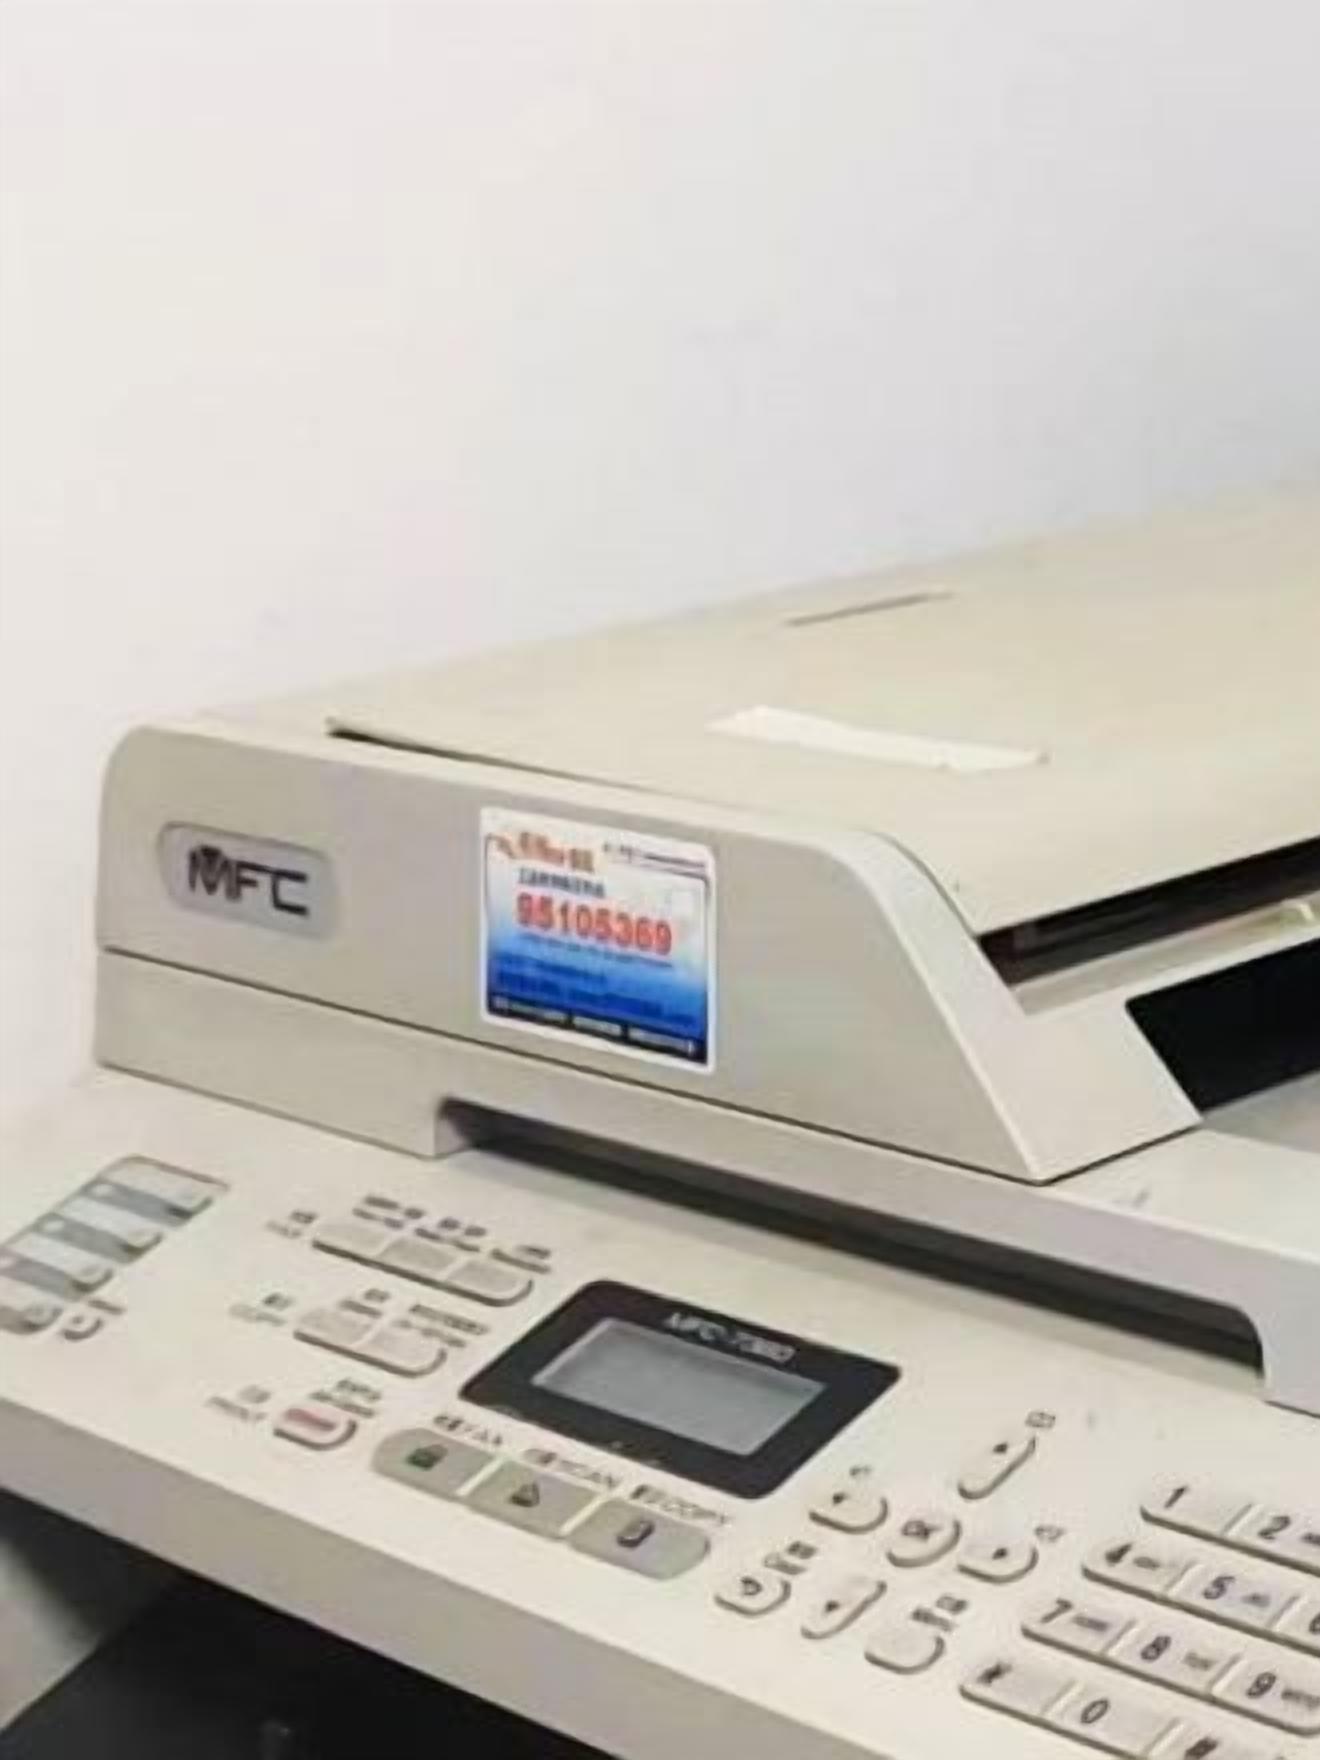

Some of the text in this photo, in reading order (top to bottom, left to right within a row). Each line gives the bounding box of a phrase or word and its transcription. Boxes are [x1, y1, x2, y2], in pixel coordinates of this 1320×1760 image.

[188, 845, 309, 916] MFC
[516, 891, 672, 956] 95105369
[1162, 1484, 1189, 1509] 1
[1258, 1514, 1291, 1541] 2
[1202, 1575, 1236, 1600] 5
[1040, 1598, 1074, 1624] 7
[1140, 1634, 1172, 1662] 8
[1246, 1671, 1278, 1698] 9
[1080, 1698, 1110, 1724] 0
